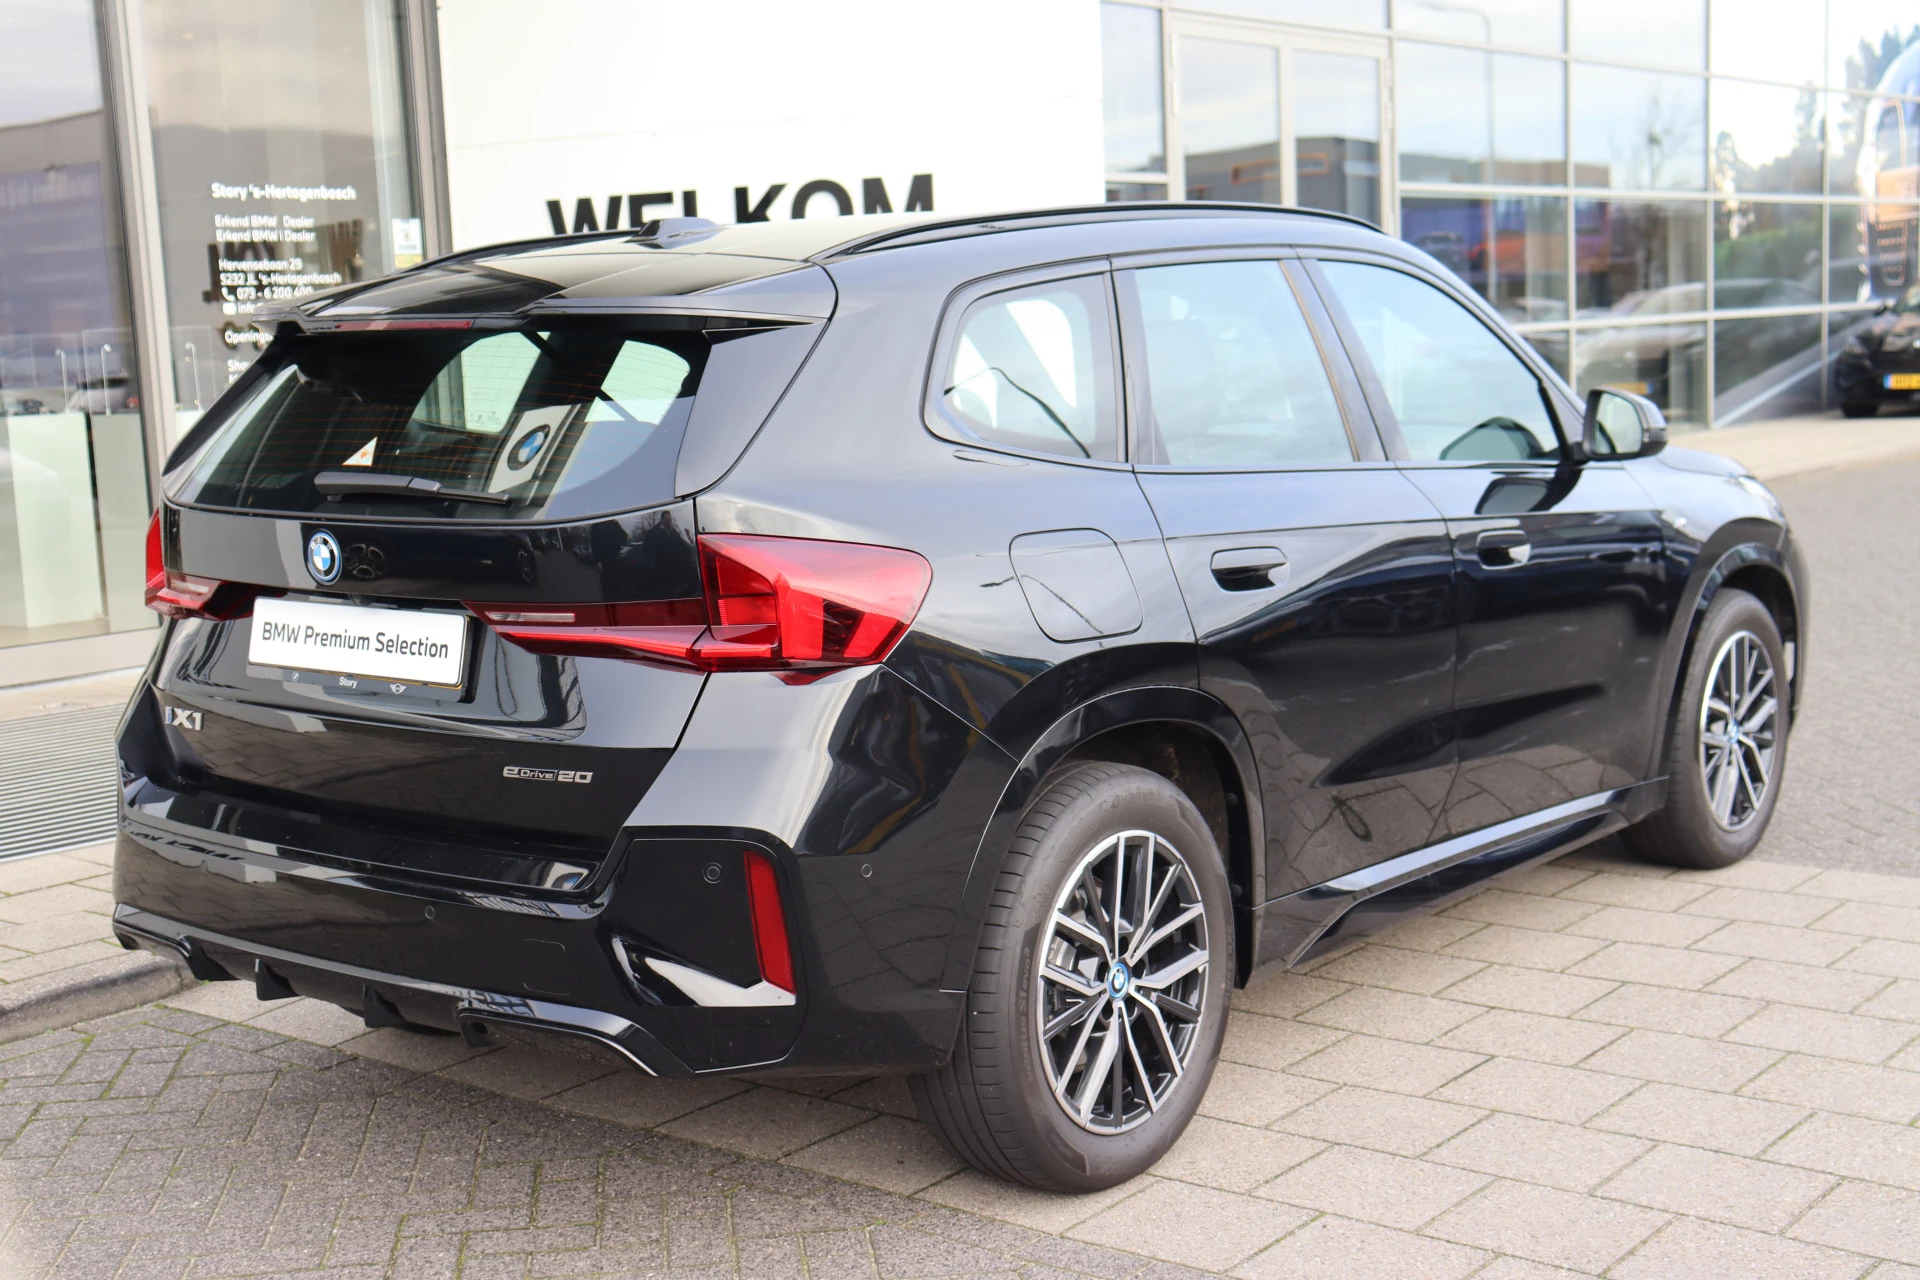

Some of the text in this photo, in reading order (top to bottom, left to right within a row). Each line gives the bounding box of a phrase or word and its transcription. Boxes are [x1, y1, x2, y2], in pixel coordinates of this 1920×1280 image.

[211, 182, 357, 202] Story 's-Hertogenbosch
[214, 214, 315, 229] Erkend BMW Dealer
[215, 229, 251, 242] Erkend
[252, 229, 278, 243] BMW
[284, 230, 316, 243] Dealer
[289, 257, 304, 271] 29
[220, 273, 246, 286] 5232
[246, 272, 259, 286] JL
[236, 286, 257, 300] 073
[264, 286, 272, 300] 6
[272, 286, 294, 300] 200
[224, 330, 274, 344] Openings
[262, 621, 449, 659] BMW Premium Selection
[339, 676, 358, 689] Story
